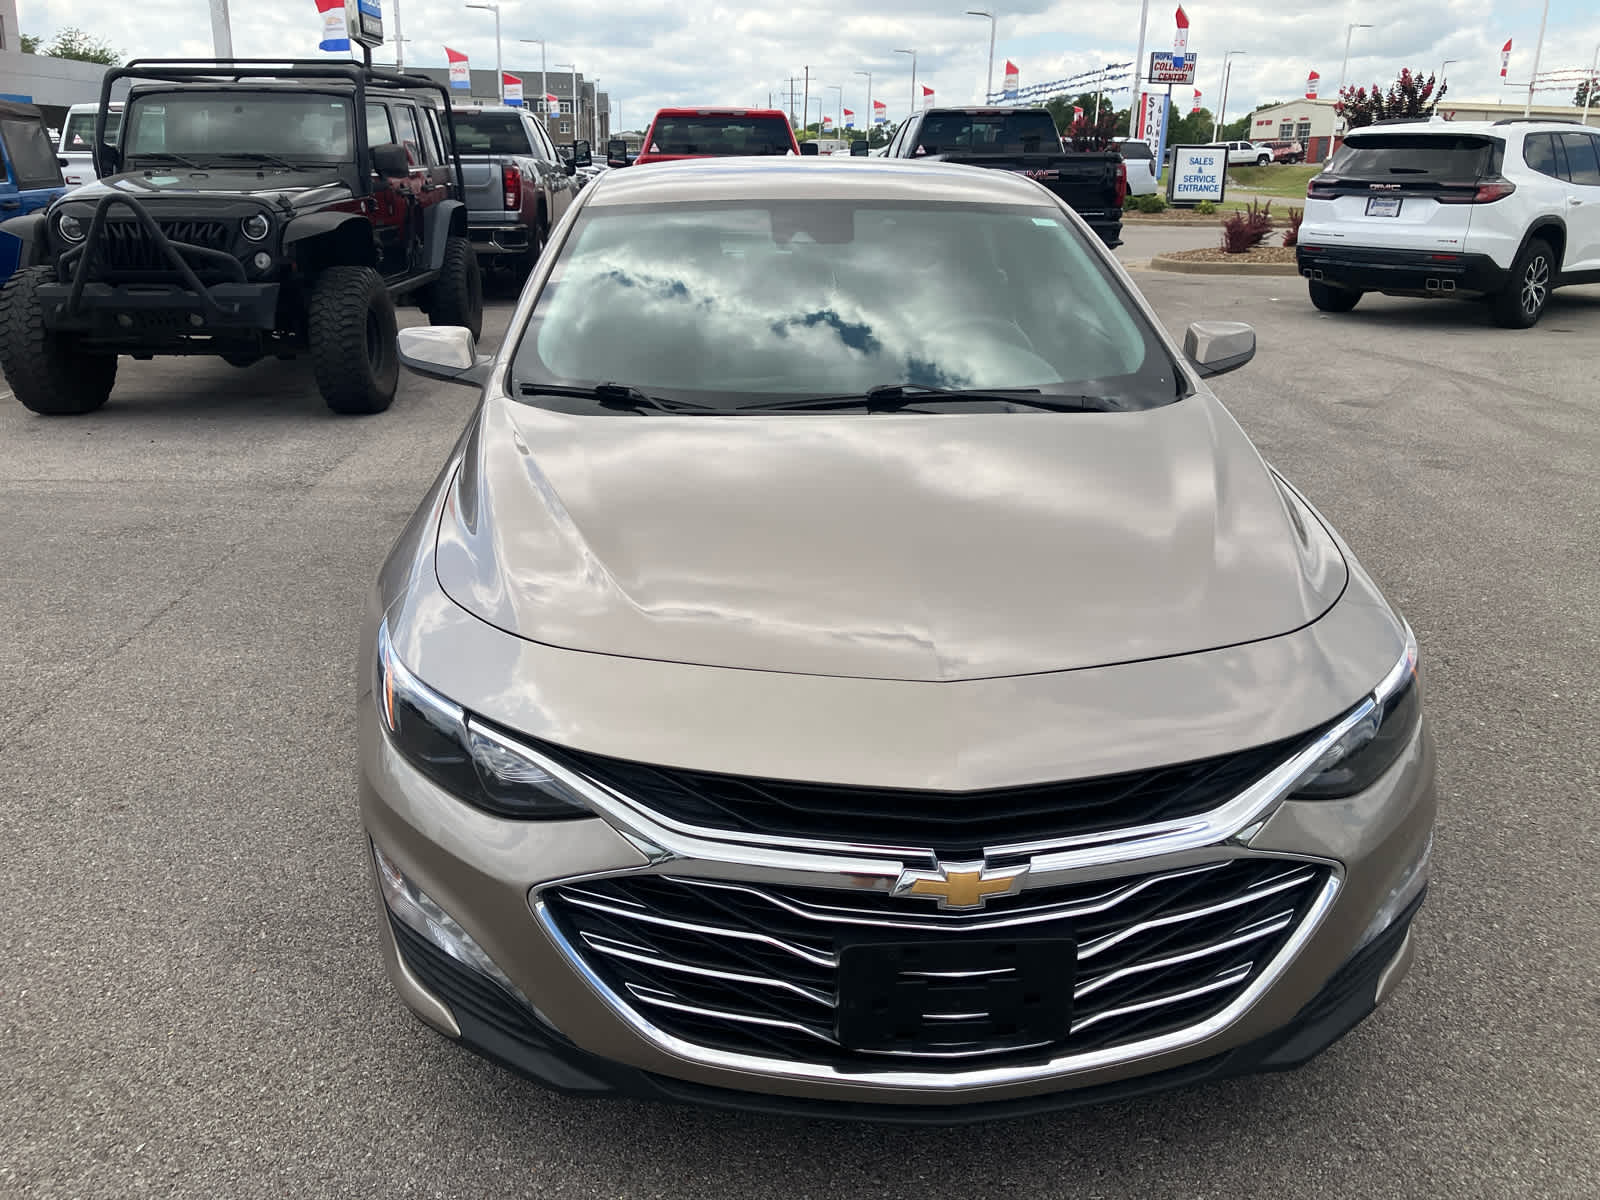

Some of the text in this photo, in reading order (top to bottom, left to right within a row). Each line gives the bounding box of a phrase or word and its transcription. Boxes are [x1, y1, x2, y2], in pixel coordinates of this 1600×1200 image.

[1154, 62, 1195, 72] COLLON
[1158, 73, 1188, 81] CENTER
[1189, 157, 1214, 165] SALES
[1184, 175, 1216, 183] SERVICE
[1178, 184, 1219, 192] ENTRANCE
[1369, 183, 1401, 191] GMC
